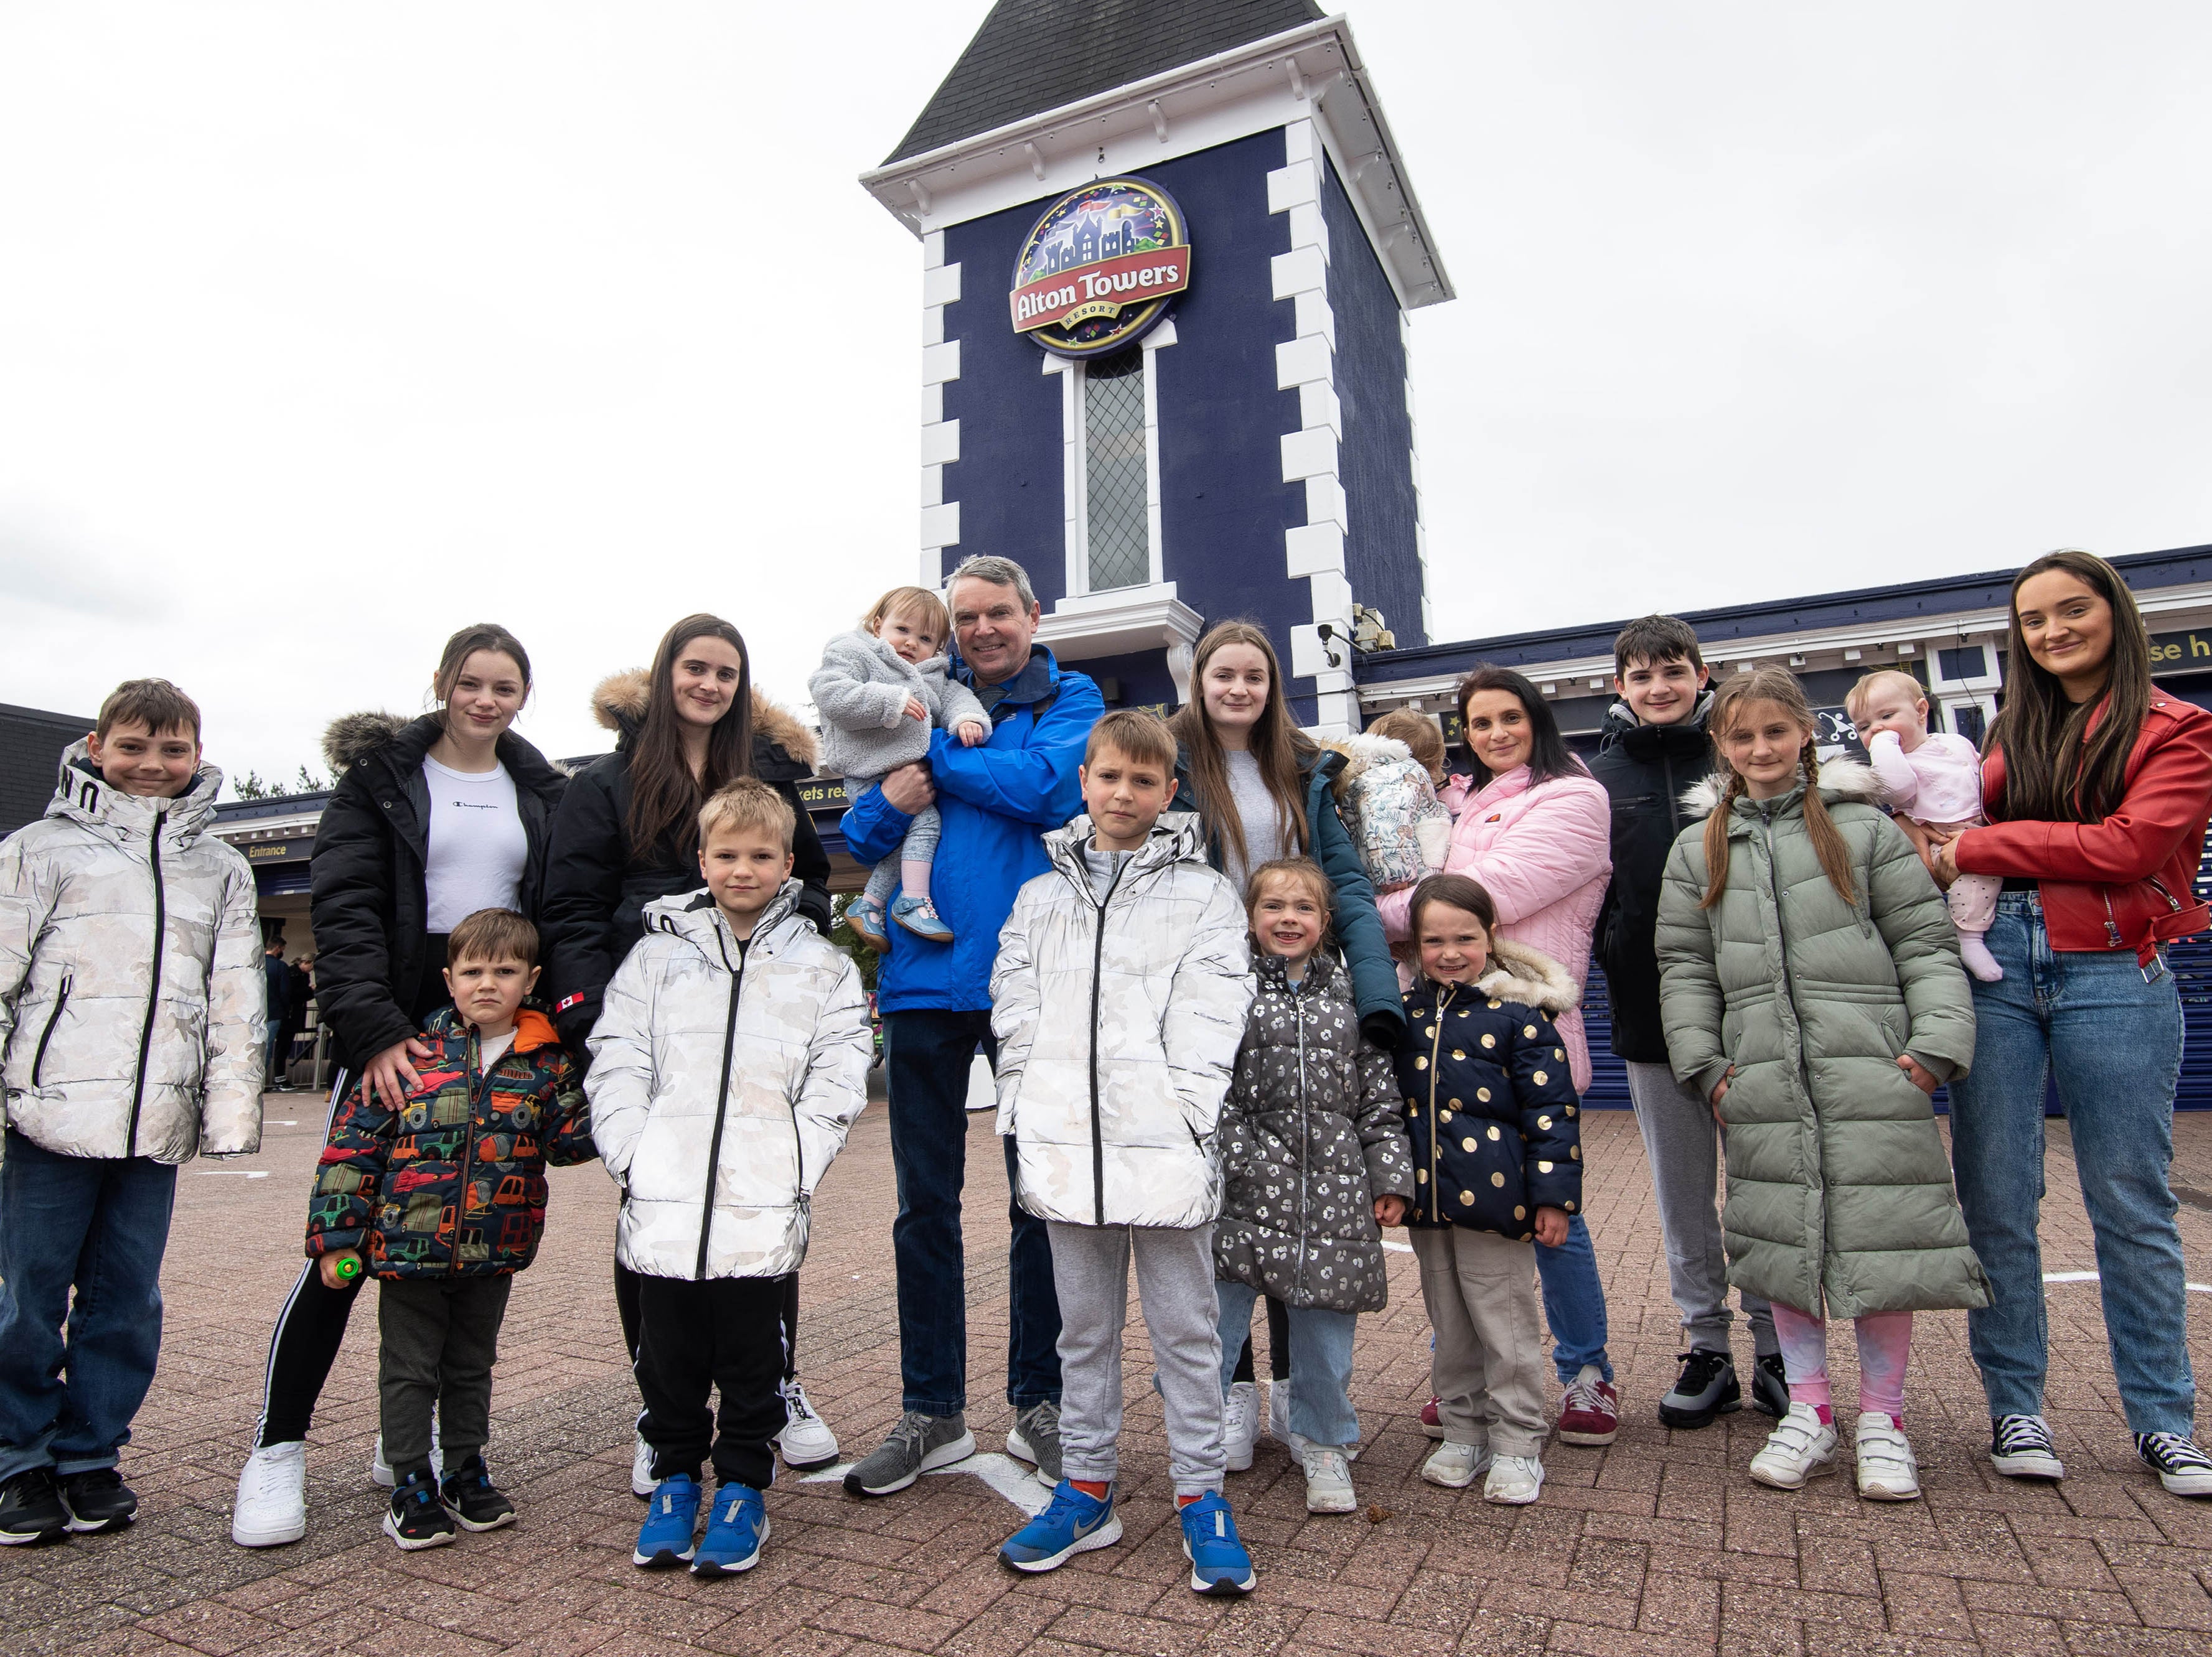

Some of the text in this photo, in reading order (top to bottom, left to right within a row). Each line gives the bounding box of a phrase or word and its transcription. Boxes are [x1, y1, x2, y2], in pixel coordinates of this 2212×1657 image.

[1017, 264, 1179, 322] Alton Towers
[1065, 305, 1115, 325] RESORT
[452, 801, 499, 810] Champion
[249, 846, 286, 858] Entrance
